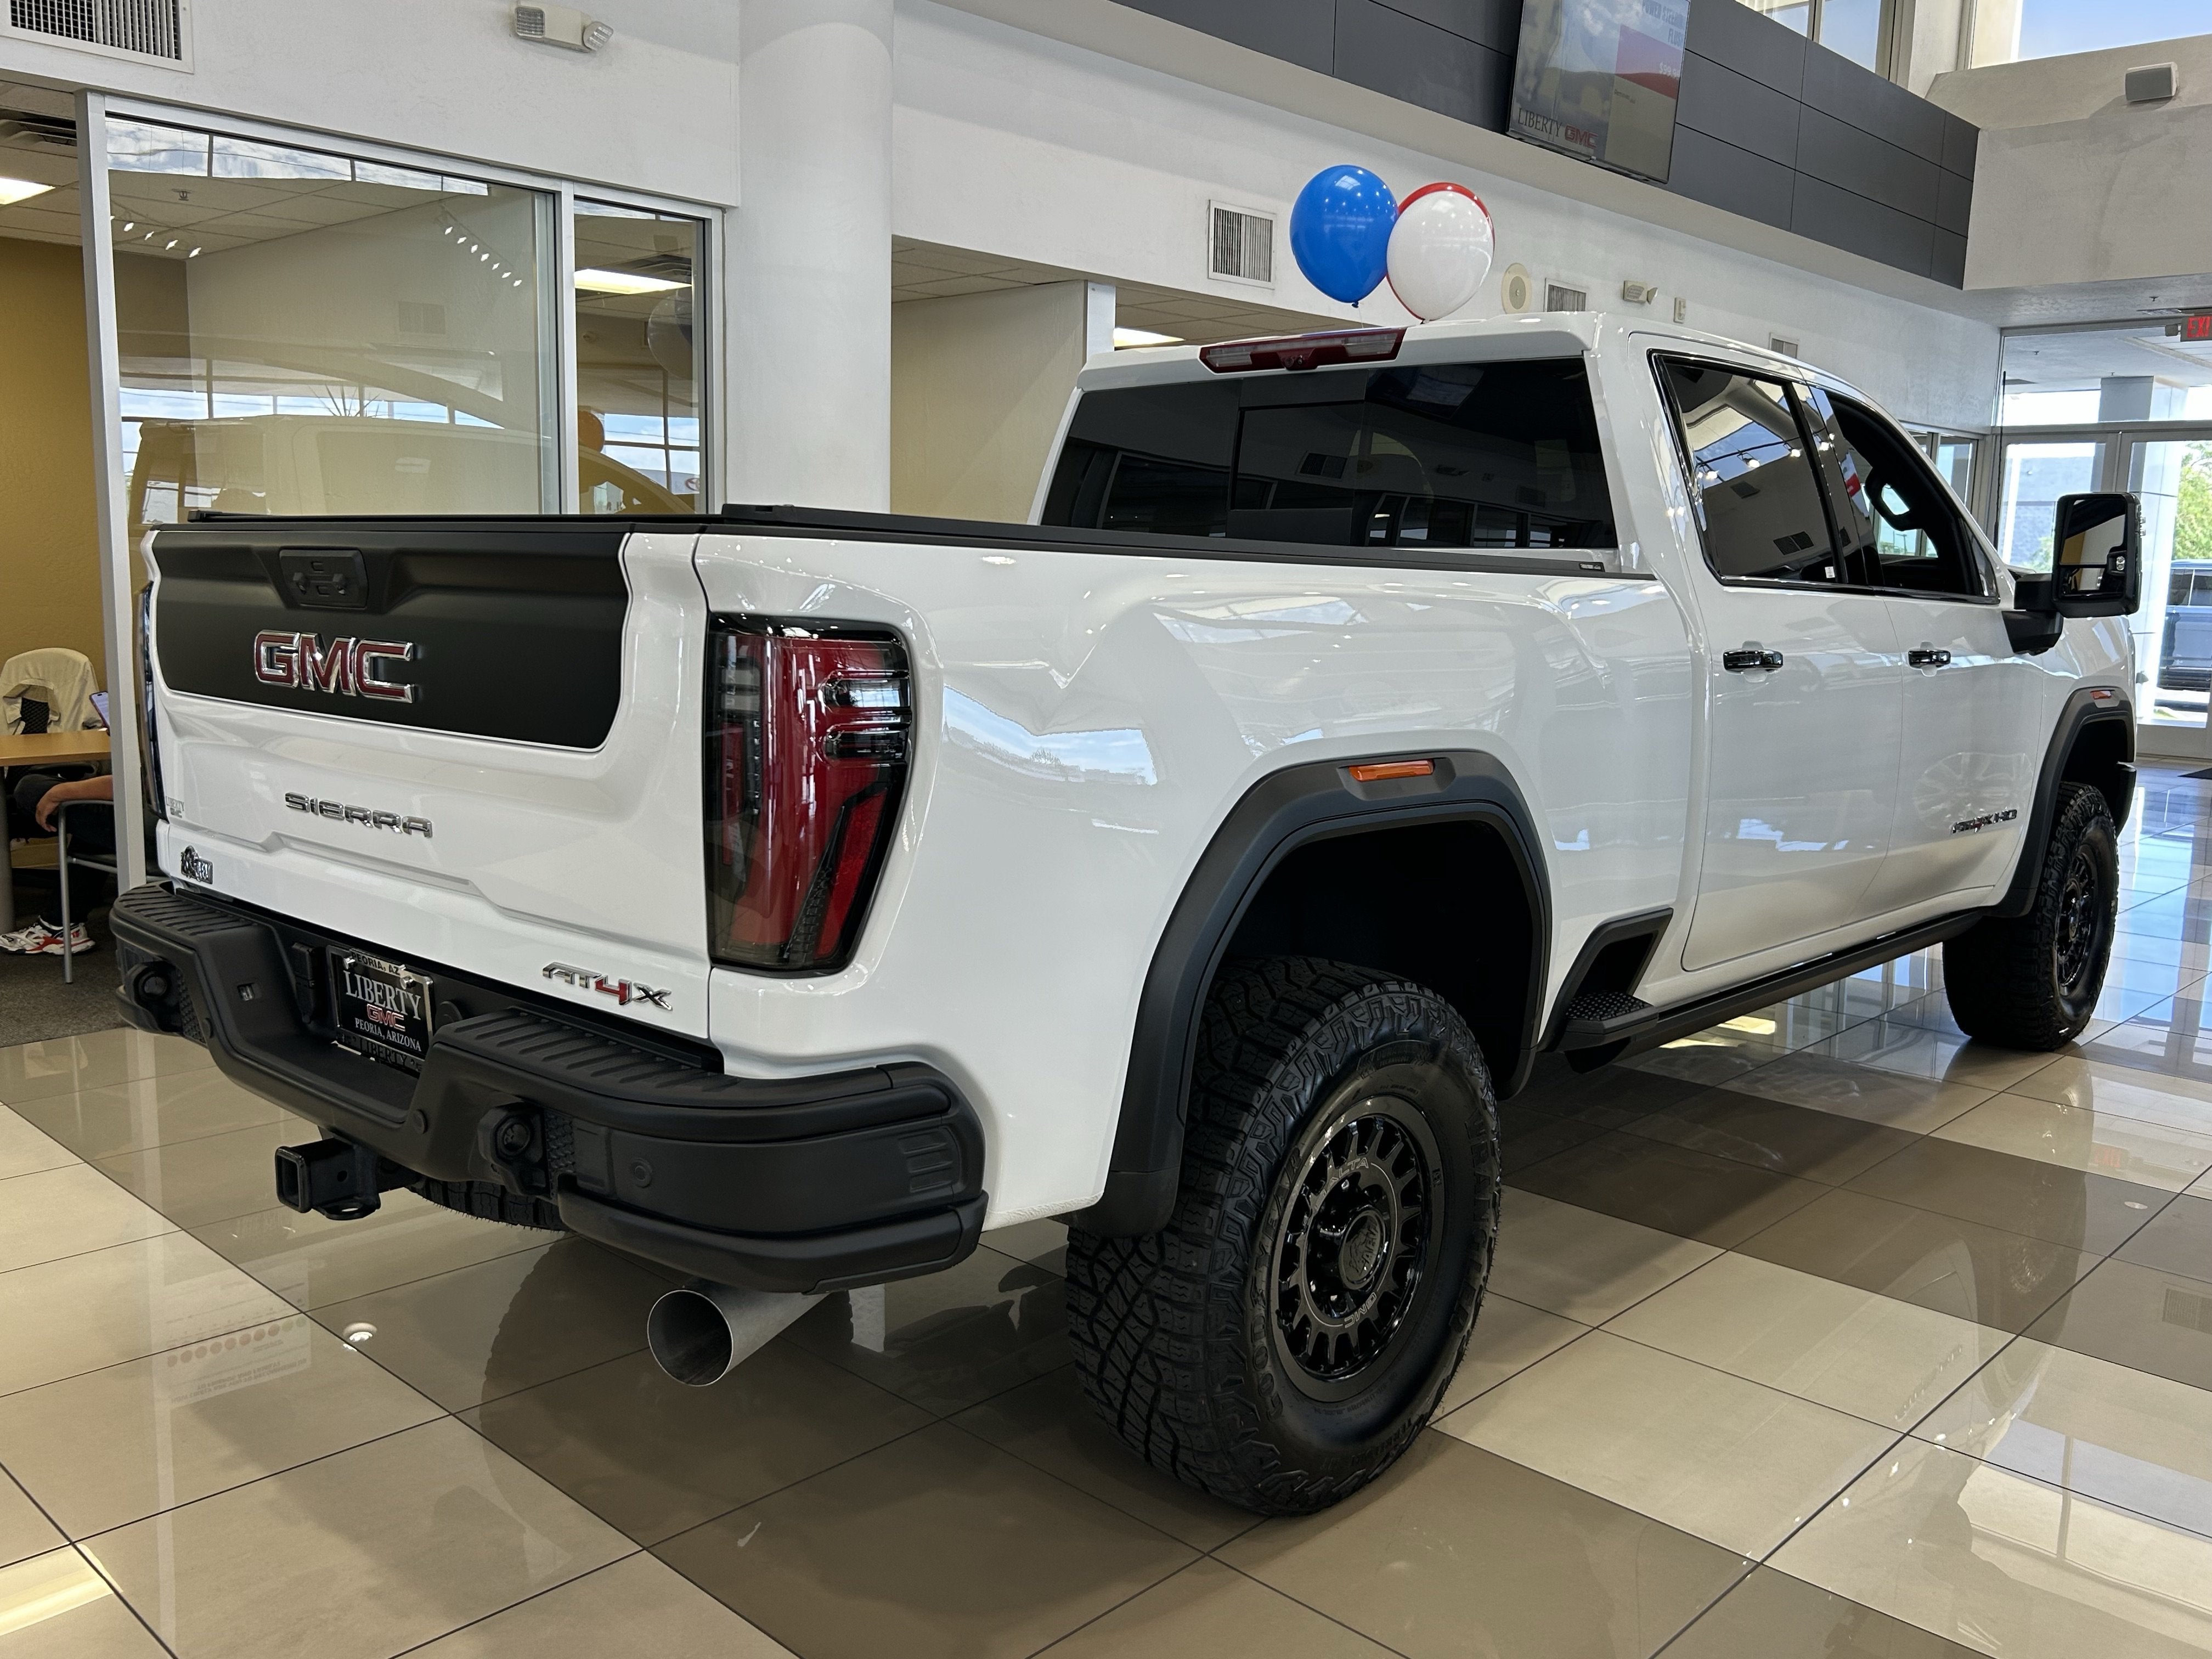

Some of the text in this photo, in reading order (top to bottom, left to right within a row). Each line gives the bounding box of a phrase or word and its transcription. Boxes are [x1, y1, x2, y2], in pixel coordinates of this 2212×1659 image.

[1517, 108, 1598, 149] LIBERTY GMC
[2187, 316, 2212, 338] EXI
[254, 629, 414, 704] GMC
[284, 791, 433, 838] SIERRA
[351, 951, 387, 972] PEORIA,
[343, 970, 421, 1021] LIBERTY
[543, 961, 674, 1011] AT4X
[354, 1017, 385, 1041] PEORIA,
[386, 1029, 422, 1052] ARIZONA
[366, 1003, 406, 1032] GMC
[359, 1037, 408, 1066] LIBERTY
[1252, 1146, 1302, 1423] GOODYEAR
[1344, 1291, 1378, 1329] GMC
